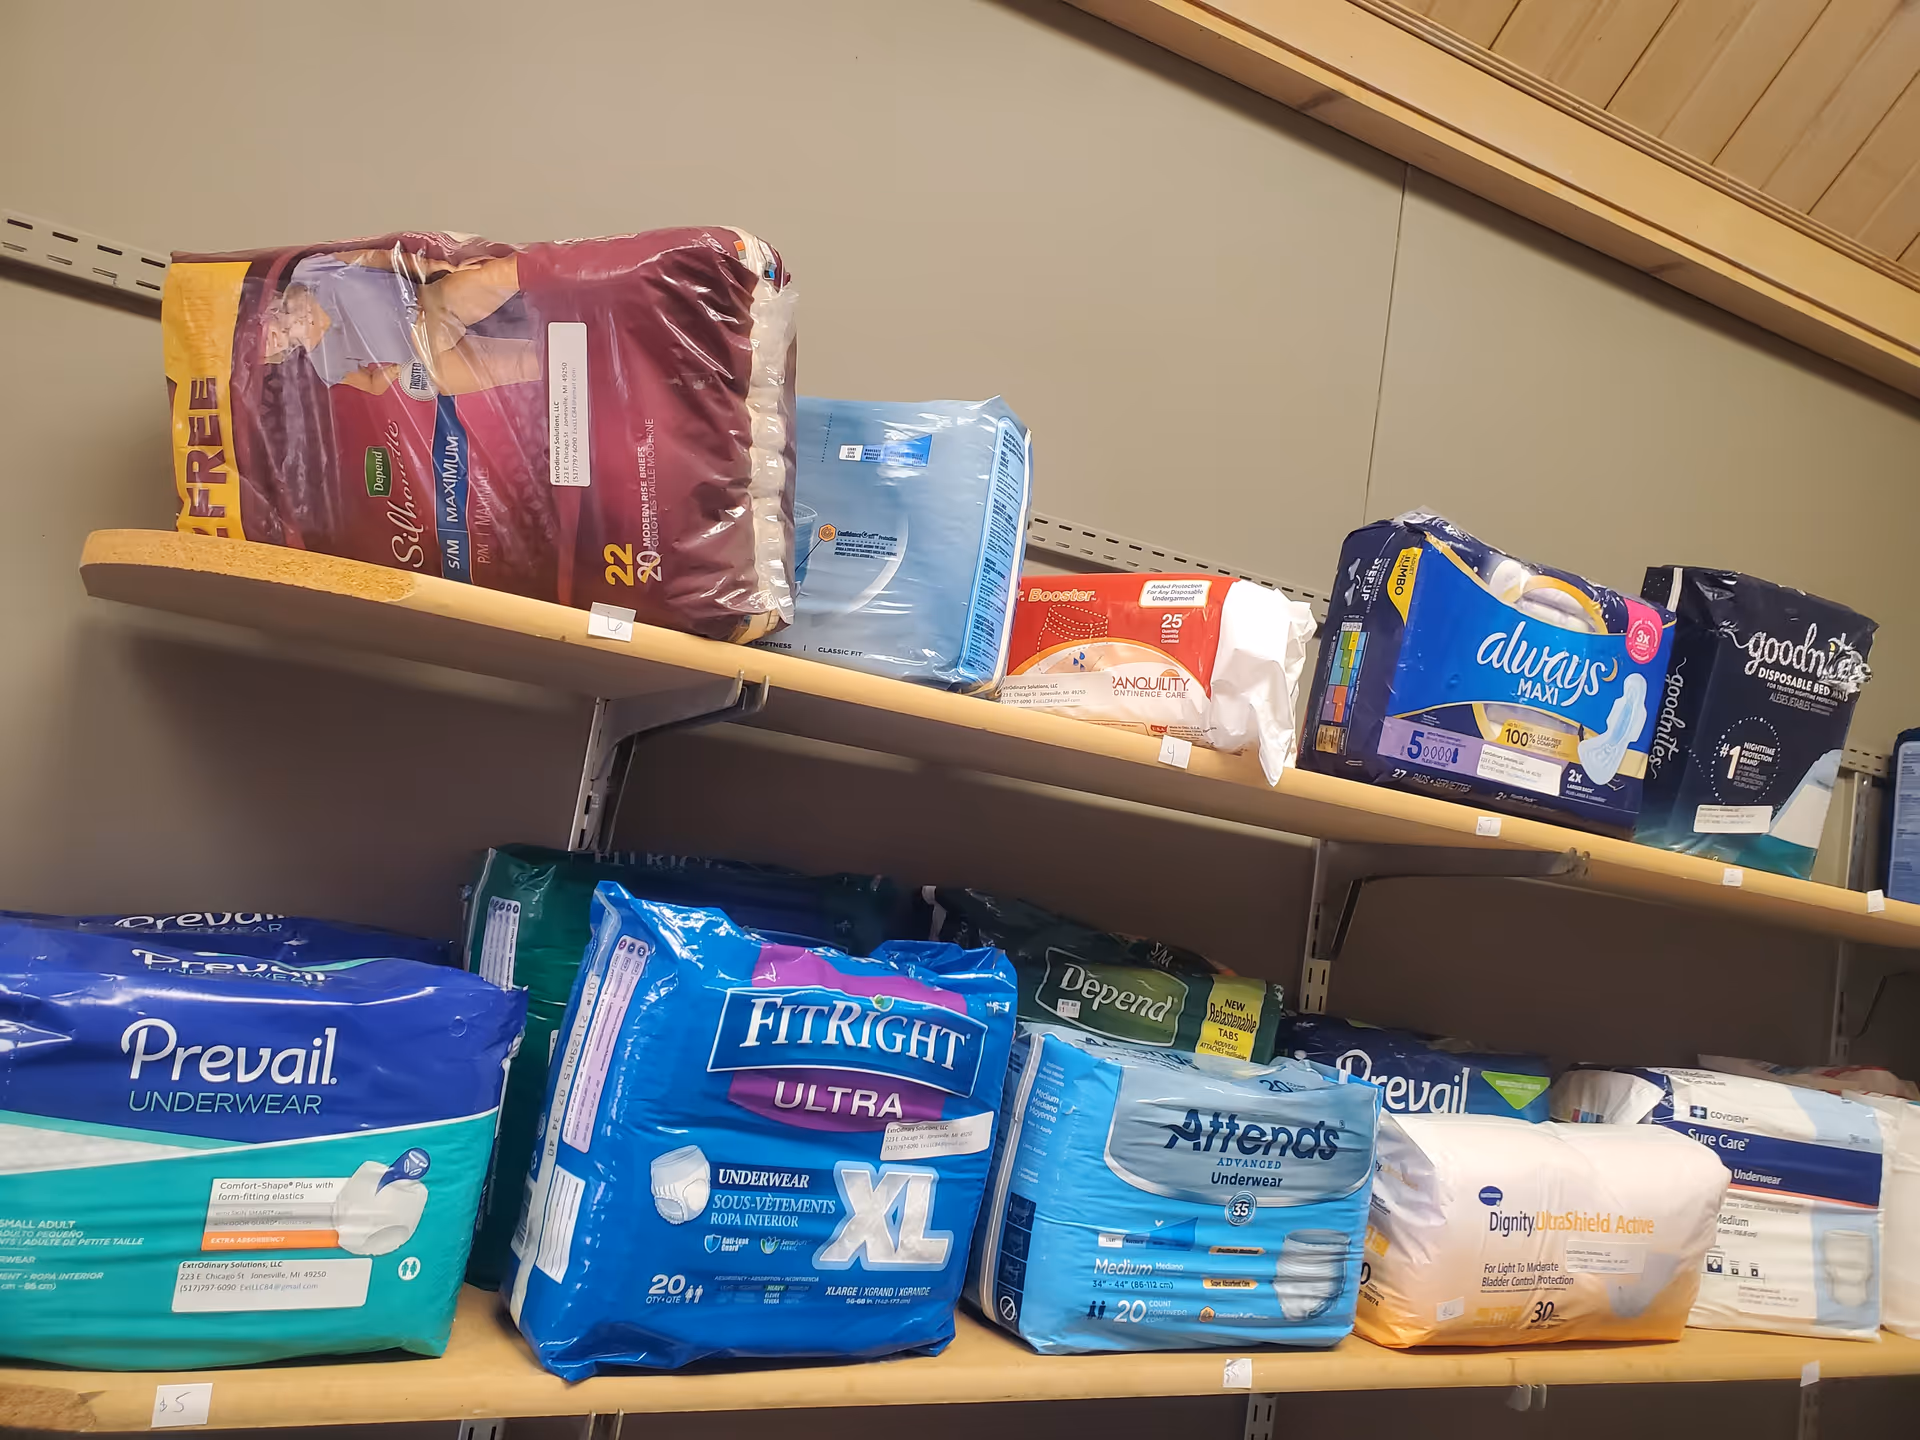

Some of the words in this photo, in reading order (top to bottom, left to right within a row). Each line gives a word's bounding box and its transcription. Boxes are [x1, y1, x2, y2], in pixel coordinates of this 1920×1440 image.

[562, 385, 568, 394] MI
[186, 377, 227, 517] FREE
[645, 418, 656, 467] MODERNE
[637, 446, 647, 478] BRIEFS
[373, 451, 384, 492] Depend
[446, 436, 459, 522] MAXIMUM
[640, 481, 649, 502] RISE
[648, 468, 656, 498] TAILLE
[385, 420, 424, 568] Silhotte
[642, 504, 651, 547] MODERN
[448, 539, 460, 569] S/M
[603, 543, 635, 587] 22
[636, 550, 663, 582] 20
[1366, 558, 1383, 584] STEP
[1394, 556, 1411, 596] JUMBO
[1028, 588, 1096, 602] Booster
[1170, 588, 1204, 596] Disposable
[1361, 586, 1372, 601] UP
[1161, 613, 1183, 629] 25
[1636, 630, 1650, 644] 3x
[818, 646, 848, 656] CLASSIC
[1476, 620, 1606, 707] always
[1758, 667, 1812, 692] DISPOSABLE
[1814, 684, 1831, 696] BED
[1776, 684, 1795, 694] TRUSTED
[1166, 691, 1186, 699] CARE
[1517, 678, 1558, 706] MAXI
[1648, 670, 1686, 772] goodnites
[1407, 730, 1424, 760] 5
[1505, 728, 1536, 747] 100%
[1536, 740, 1560, 750] COMFORT
[1742, 750, 1773, 763] PROTECTION
[1743, 742, 1776, 756] NIGHTTIME
[1392, 768, 1407, 779] 27
[1412, 773, 1430, 784] PADS
[1568, 769, 1582, 784] 2x
[114, 912, 286, 930] Preva
[1150, 942, 1172, 968] S/M
[1060, 962, 1172, 1023] Depend
[1224, 999, 1246, 1012] NEW
[1208, 1004, 1257, 1034] Refastenable
[739, 996, 972, 1071] FITRIGHT
[1218, 1027, 1240, 1042] TABS
[120, 1017, 338, 1085] Prevail
[1200, 1042, 1225, 1056] ATTACHES
[1214, 1040, 1238, 1052] NOUVEAU
[1259, 1079, 1294, 1093] 20
[1336, 1049, 1470, 1114] Prevail
[129, 1090, 322, 1116] UNDERWEAR
[773, 1080, 904, 1119] ULTRA
[1032, 1096, 1058, 1114] Mediano
[1036, 1088, 1060, 1104] Medium
[1028, 1106, 1057, 1124] Moyenne
[1160, 1108, 1340, 1162] Attends
[1688, 1128, 1716, 1146] Sure
[1216, 1158, 1282, 1170] ADVANCED
[295, 1181, 313, 1190] Plus
[315, 1181, 334, 1189] with
[718, 1168, 810, 1188] UNDERWEAR
[1210, 1172, 1284, 1188] Underwear
[1734, 1168, 1783, 1185] Underwear
[218, 1192, 270, 1202] form-fitting
[272, 1192, 305, 1200] elastics
[821, 1168, 952, 1264] XL
[1232, 1202, 1250, 1217] 35
[0, 1219, 36, 1229] SMALL
[37, 1220, 76, 1229] ADULT
[710, 1212, 741, 1226] ROPA
[744, 1214, 799, 1228] INTERIOR
[1536, 1210, 1611, 1234] UltraShield
[1615, 1215, 1655, 1234] Active
[22, 1238, 61, 1246] ADULTE
[78, 1238, 110, 1246] PETITE
[112, 1238, 144, 1246] TAILLE
[36, 1230, 84, 1238] PEQUEÑO
[182, 1262, 229, 1270] ExtrOdinary
[230, 1261, 268, 1270] Solutions,
[1094, 1258, 1153, 1276] Medium
[1155, 1262, 1184, 1271] Mediano
[1484, 1262, 1496, 1274] For
[1497, 1262, 1516, 1276] Light
[1517, 1262, 1525, 1273] To
[1526, 1262, 1560, 1274] Moderate
[30, 1272, 57, 1280] ROPA
[58, 1272, 104, 1280] INTERIOR
[180, 1273, 195, 1281] 223
[205, 1272, 236, 1280] Chicago
[236, 1272, 245, 1280] St
[250, 1272, 288, 1280] Jonesville,
[648, 1274, 686, 1295] 20
[1092, 1280, 1107, 1288] 34"
[1114, 1280, 1129, 1288] 44"
[1130, 1280, 1158, 1290] (86-112
[1159, 1281, 1174, 1290] cm)
[1482, 1276, 1510, 1288] Bladder
[1511, 1275, 1536, 1287] Control
[1536, 1274, 1574, 1286] Protection
[825, 1286, 859, 1296] XLARGE
[863, 1286, 894, 1297] XGRAND
[898, 1286, 932, 1297] XGRANDE
[1112, 1300, 1147, 1324] 20
[1148, 1300, 1172, 1308] COUNT
[1530, 1301, 1555, 1324] 30
